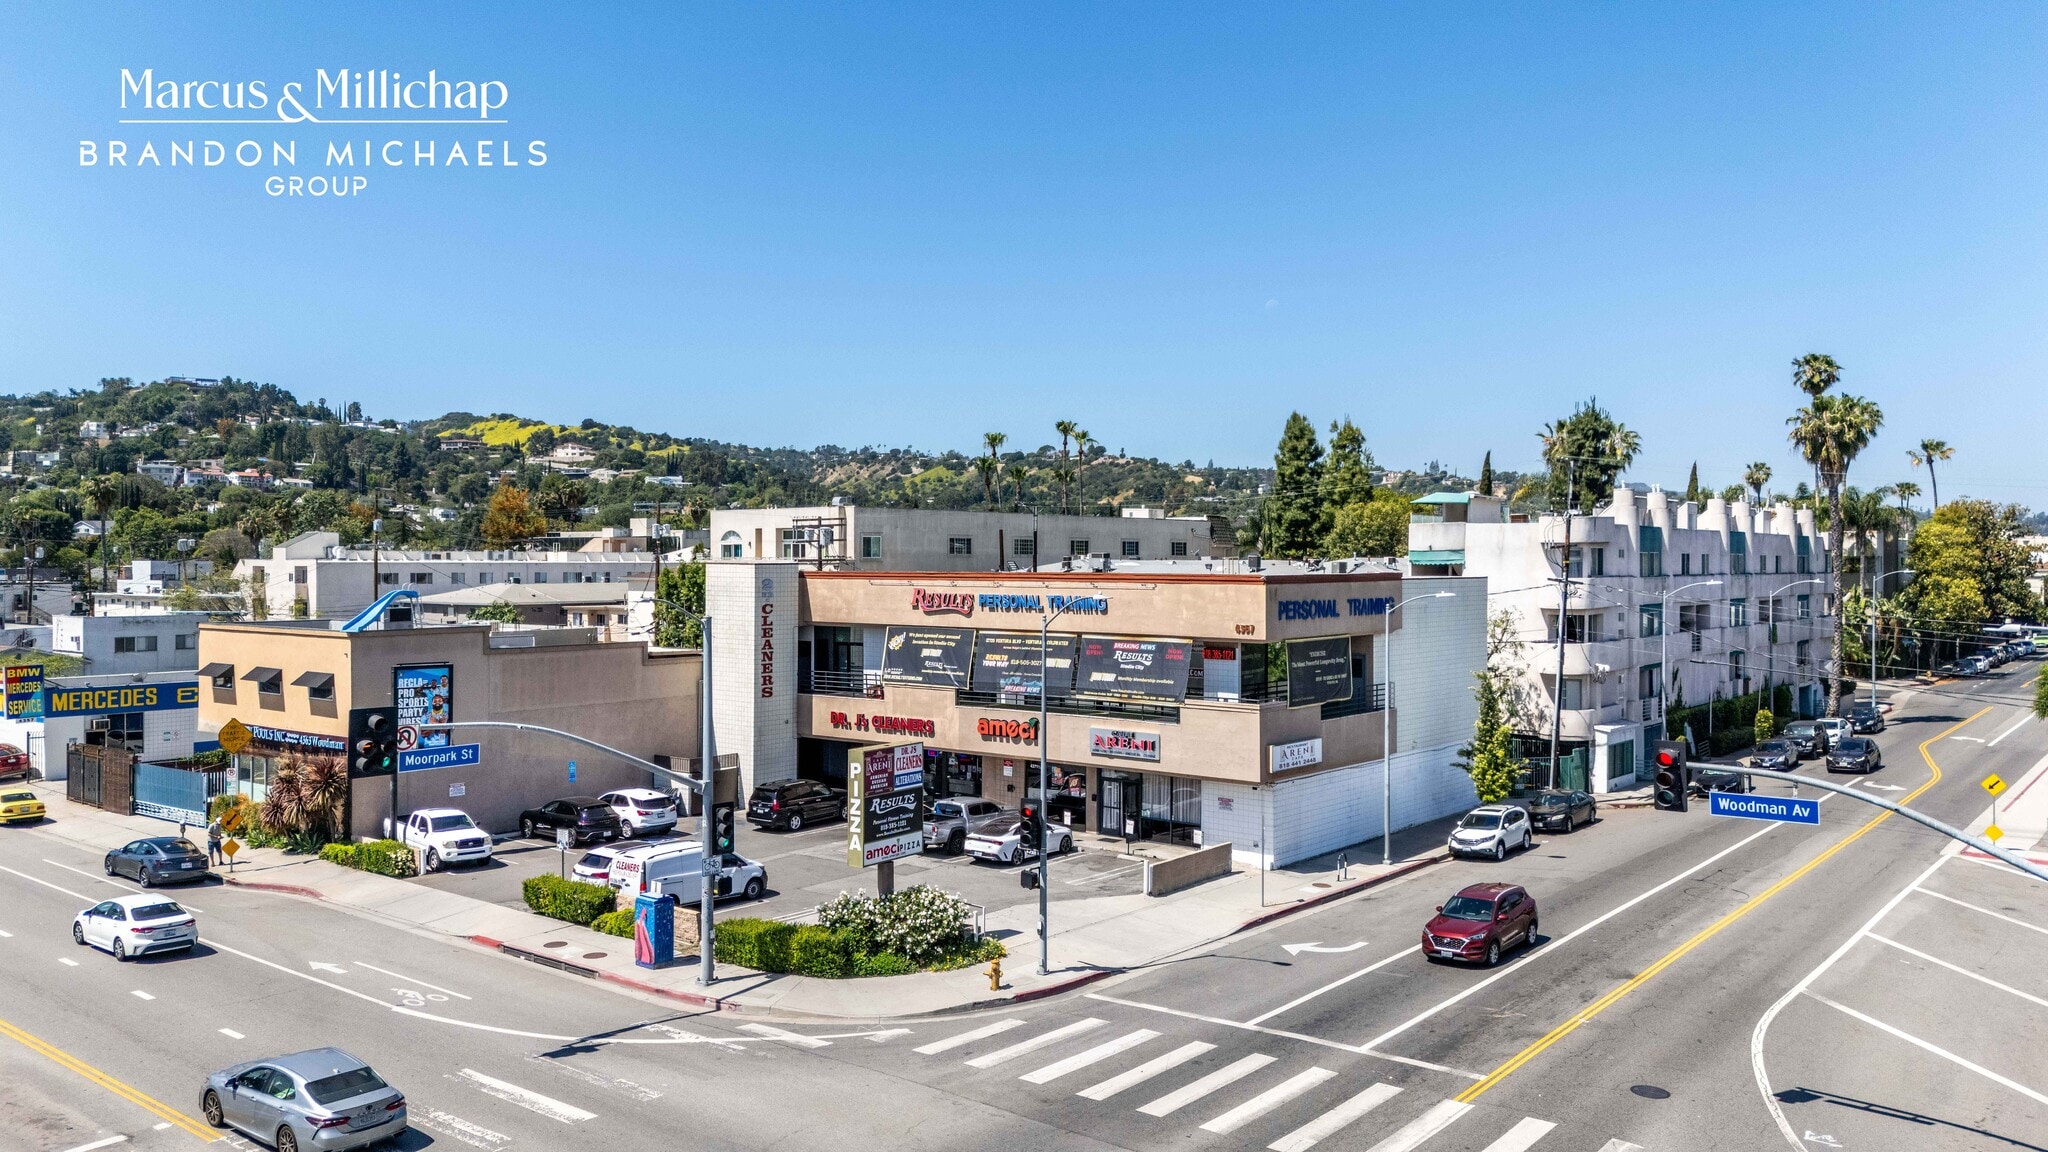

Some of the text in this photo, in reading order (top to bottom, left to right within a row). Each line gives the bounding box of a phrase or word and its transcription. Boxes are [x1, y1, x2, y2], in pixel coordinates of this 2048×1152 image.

[912, 588, 1108, 614] RESULTS PERSONAL TRAINING
[1278, 597, 1395, 620] PERSONAL TRAINING
[761, 604, 774, 698] CLEANERS
[1113, 651, 1153, 666] RESULTS
[7, 668, 40, 678] BMW
[7, 682, 42, 694] MERCEDES
[398, 689, 414, 698] PRO
[52, 687, 158, 711] MERCEDES
[398, 698, 428, 708] SPORTS
[9, 699, 42, 715] SERVICE
[398, 708, 424, 717] PARTY
[831, 711, 934, 734] DR. J's CLEANERS
[253, 727, 273, 741] POOLS
[274, 730, 286, 742] INC
[312, 737, 344, 750] Woodman
[1093, 734, 1155, 752] ARENI
[405, 749, 473, 766] Moorpark St
[1281, 746, 1314, 760] ARENI
[867, 760, 892, 773] ARENI
[895, 754, 922, 771] CLEANERS
[870, 773, 889, 781] ARMENIAN
[895, 773, 922, 787] ALTERATIONS
[870, 783, 888, 791] AMERICAN
[849, 762, 861, 851] PIZZA
[869, 794, 917, 814] RESULTS
[1718, 798, 1811, 817] Woodman Av
[900, 840, 921, 852] PIZZA
[616, 861, 640, 873] CLEANERS
